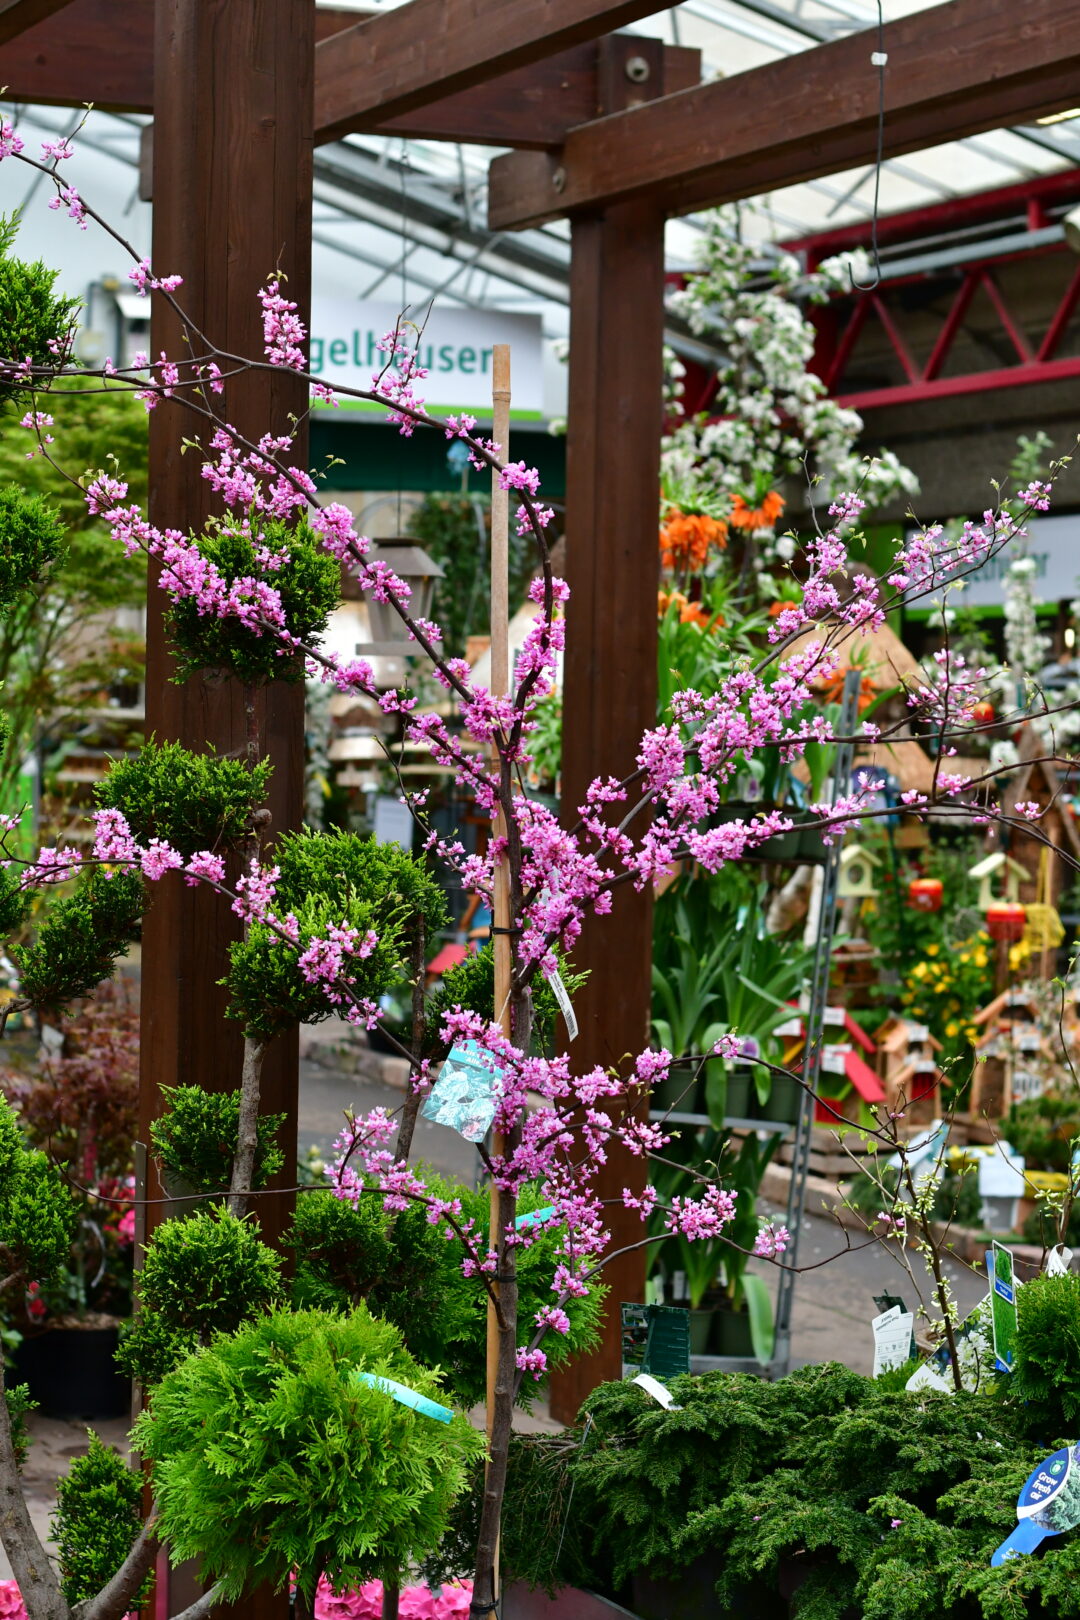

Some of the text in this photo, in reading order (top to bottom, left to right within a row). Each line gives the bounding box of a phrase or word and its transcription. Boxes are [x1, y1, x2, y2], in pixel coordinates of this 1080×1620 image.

[1038, 1472, 1058, 1486] Grow
[1032, 1479, 1051, 1495] fresh
[1030, 1491, 1042, 1500] air
